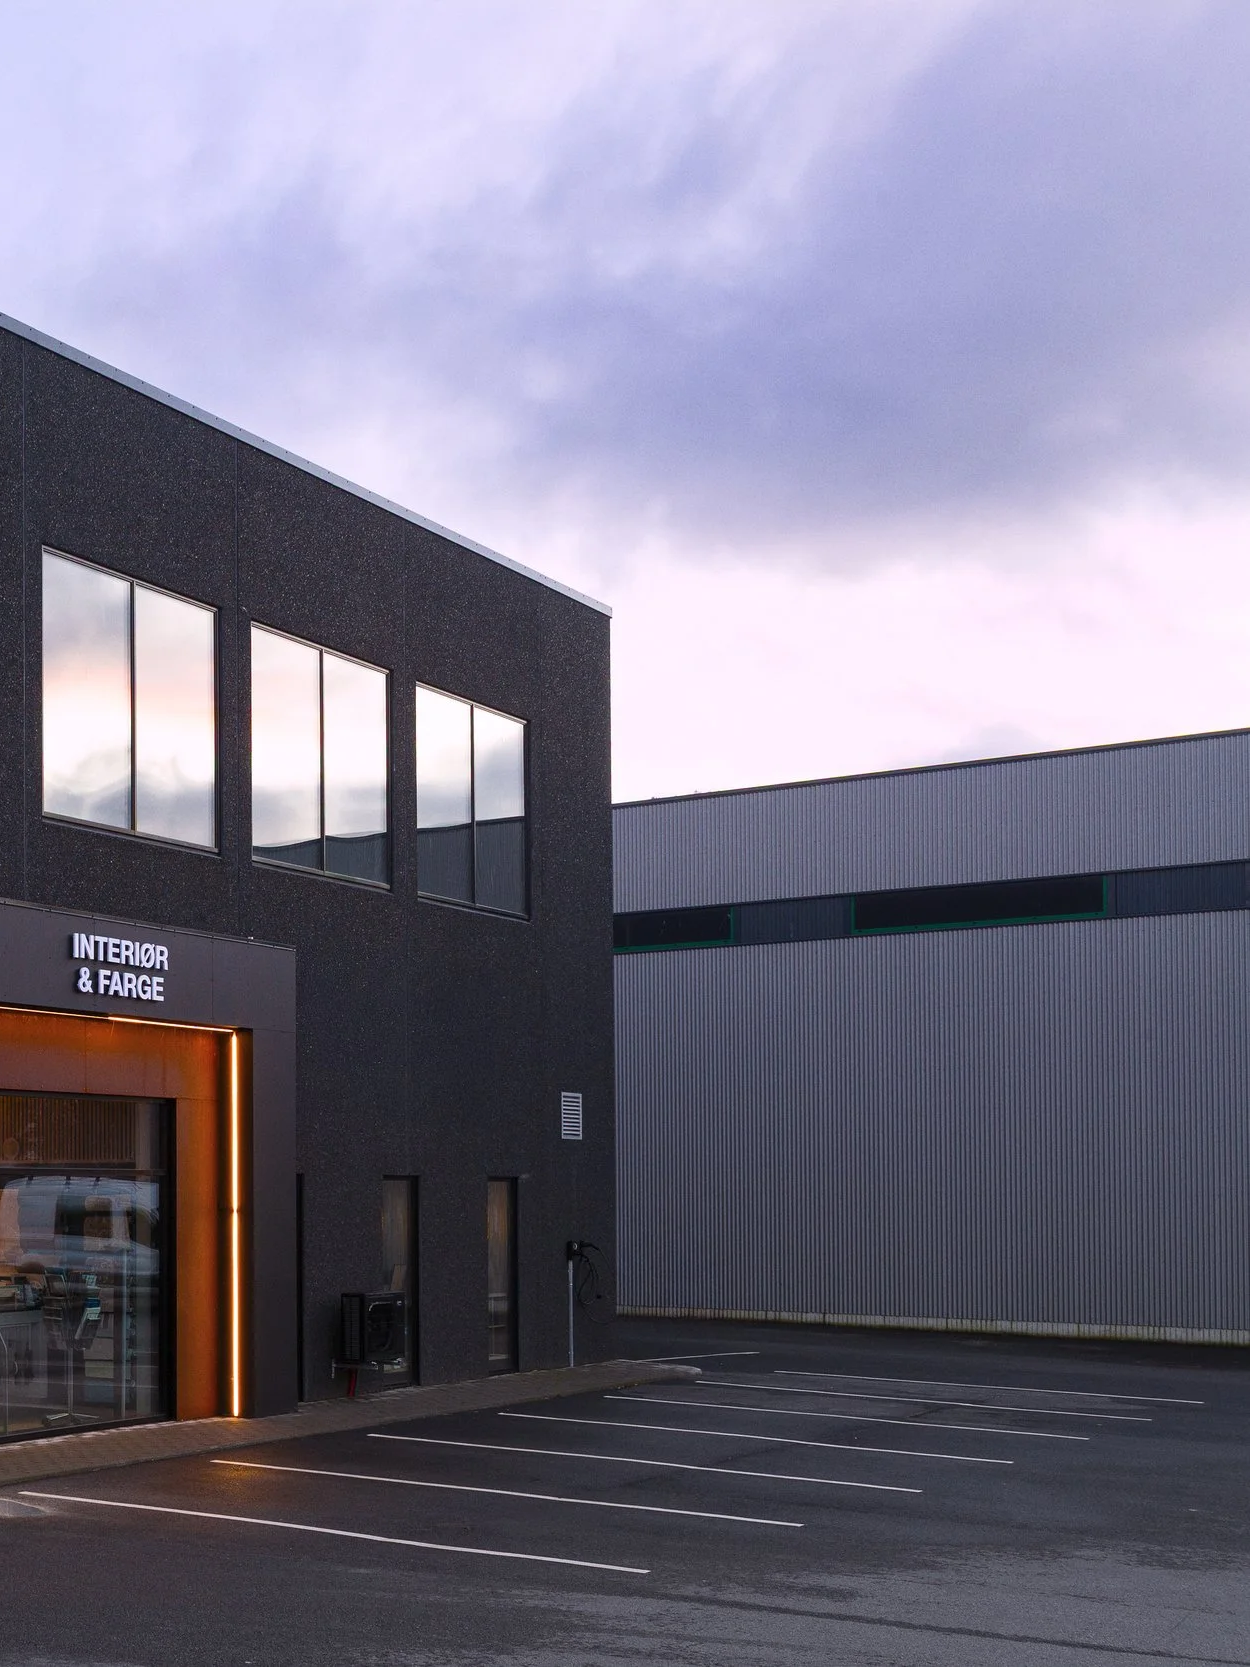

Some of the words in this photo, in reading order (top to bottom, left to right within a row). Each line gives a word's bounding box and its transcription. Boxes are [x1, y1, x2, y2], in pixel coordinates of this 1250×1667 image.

[72, 932, 169, 971] INTERIØR
[77, 967, 93, 993] &
[98, 969, 165, 1002] FARGE
